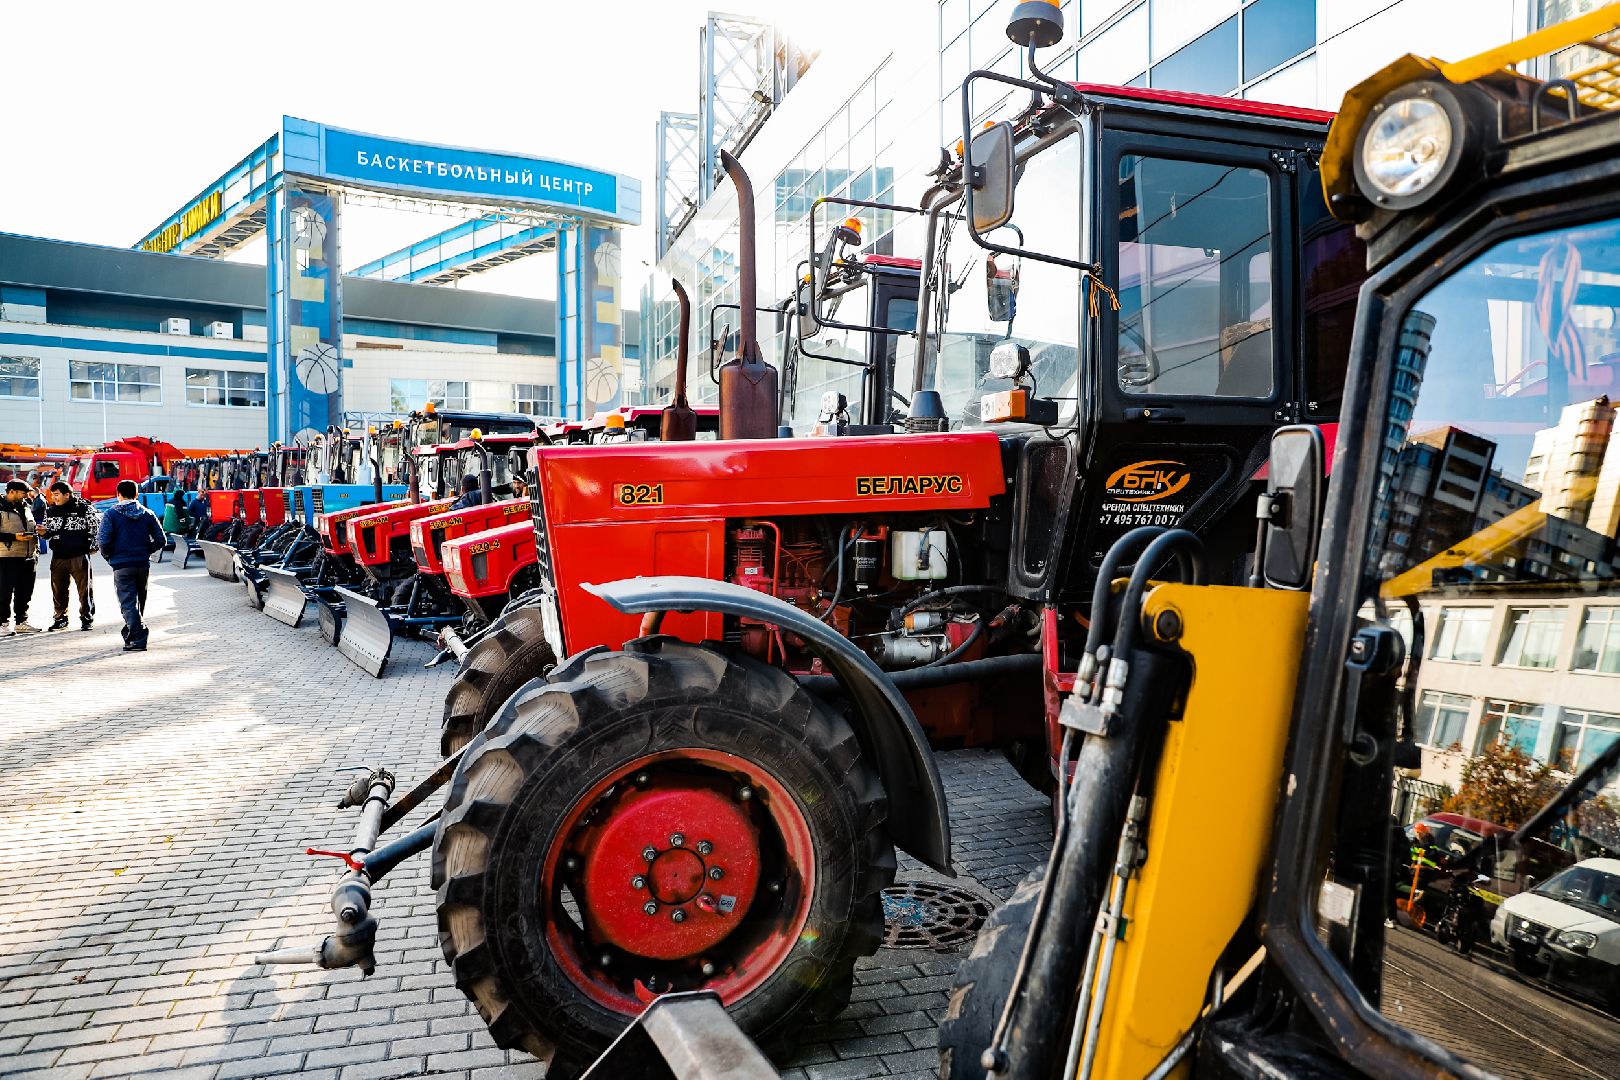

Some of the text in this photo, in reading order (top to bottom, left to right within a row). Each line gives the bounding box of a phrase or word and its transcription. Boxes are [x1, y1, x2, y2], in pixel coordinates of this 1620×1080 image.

[357, 150, 593, 196] БАСКЕТБОЛЬНЫЙ ЦЕНТР
[856, 475, 962, 496] БЕЛАРУС
[1102, 503, 1184, 513] АРЕНДА СПЕЦТЕХНИКИ
[1099, 514, 1112, 524] +7
[1113, 515, 1132, 524] 495
[1134, 515, 1153, 524] 767
[470, 538, 501, 555] 320.4
